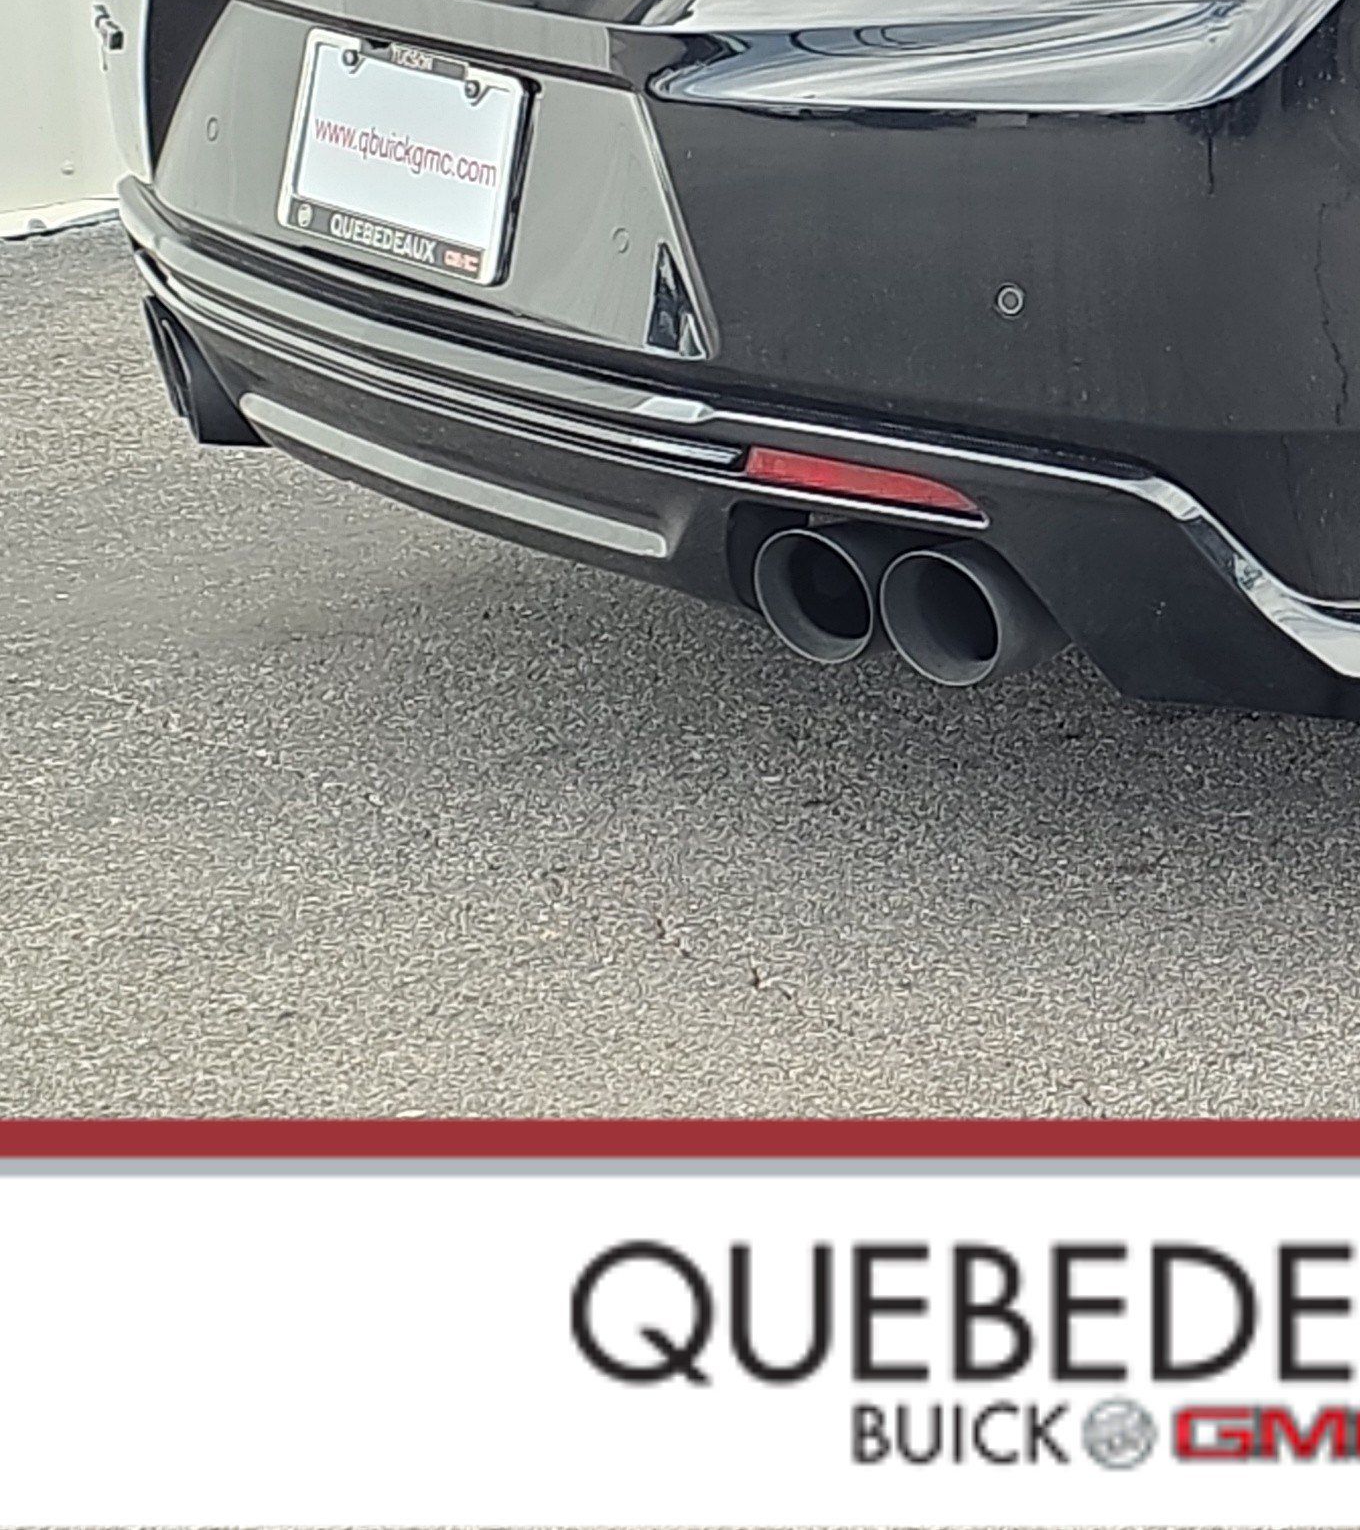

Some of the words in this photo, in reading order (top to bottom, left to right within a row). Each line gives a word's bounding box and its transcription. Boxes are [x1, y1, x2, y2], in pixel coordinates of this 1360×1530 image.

[390, 43, 434, 71] TUCSON
[314, 119, 498, 187] www.qbuickgmc.com
[330, 213, 437, 265] QUEBEDEAUX
